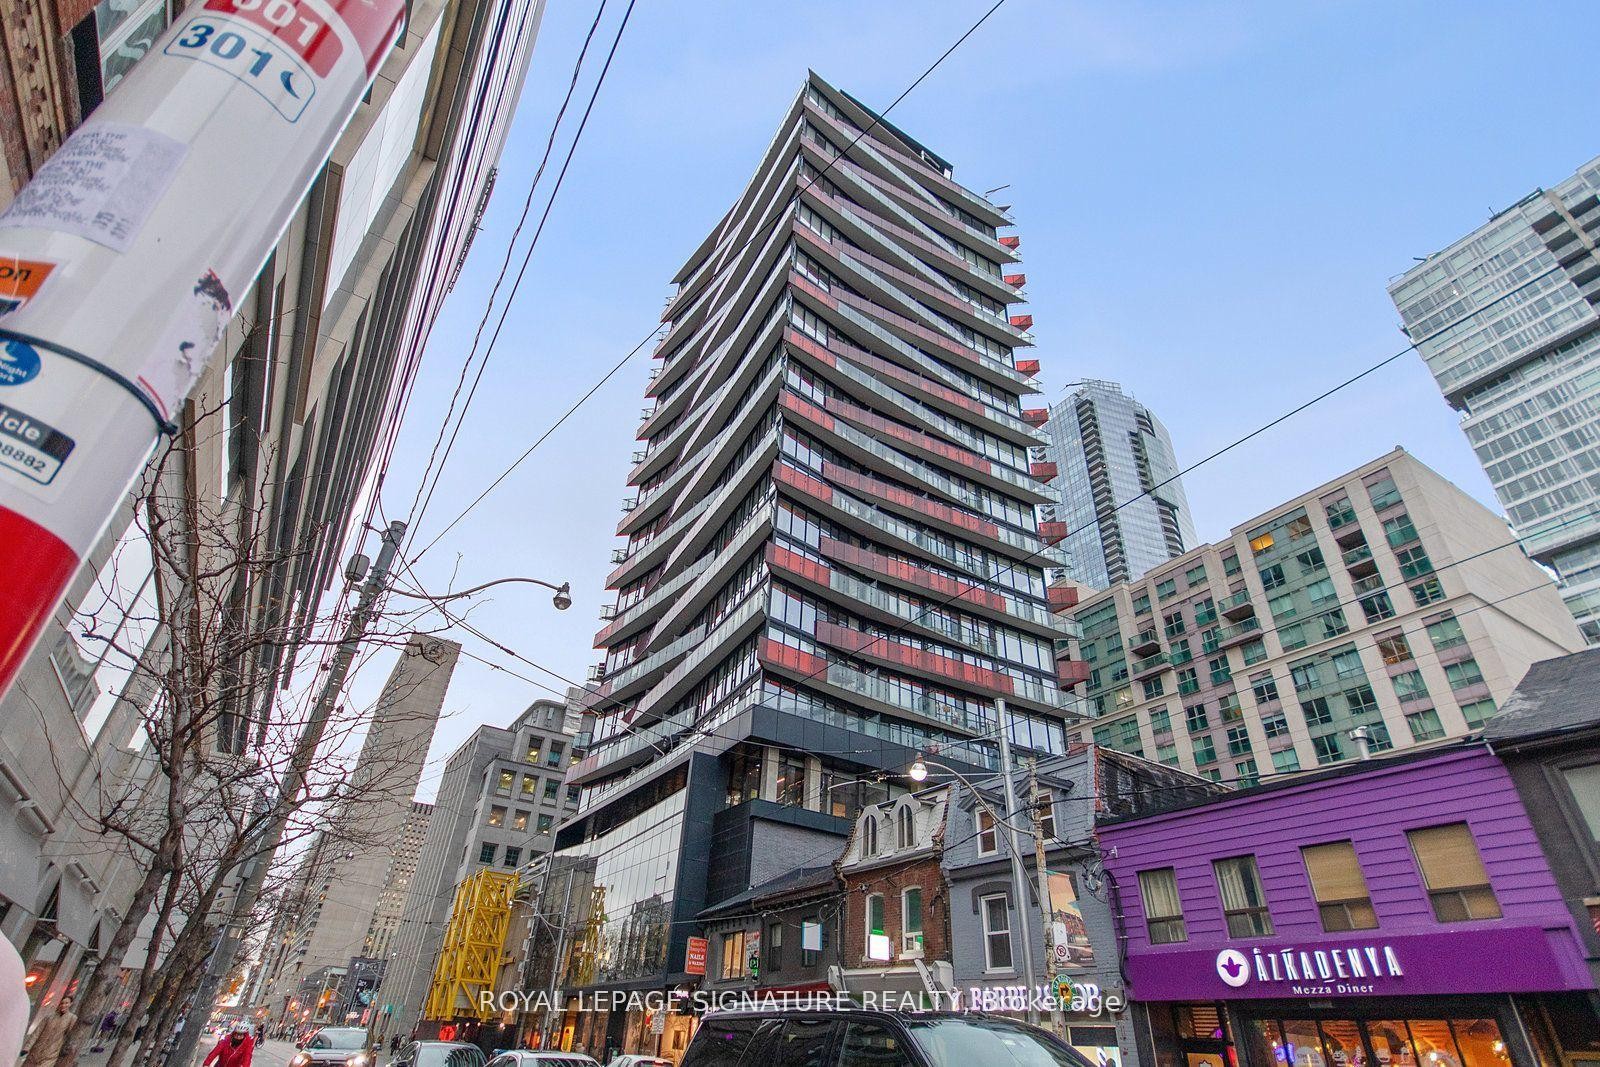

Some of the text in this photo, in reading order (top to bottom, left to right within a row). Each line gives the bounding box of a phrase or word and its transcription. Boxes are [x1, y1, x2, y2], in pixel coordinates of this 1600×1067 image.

[179, 24, 273, 78] 301
[1292, 983, 1375, 995] Mezza Diner
